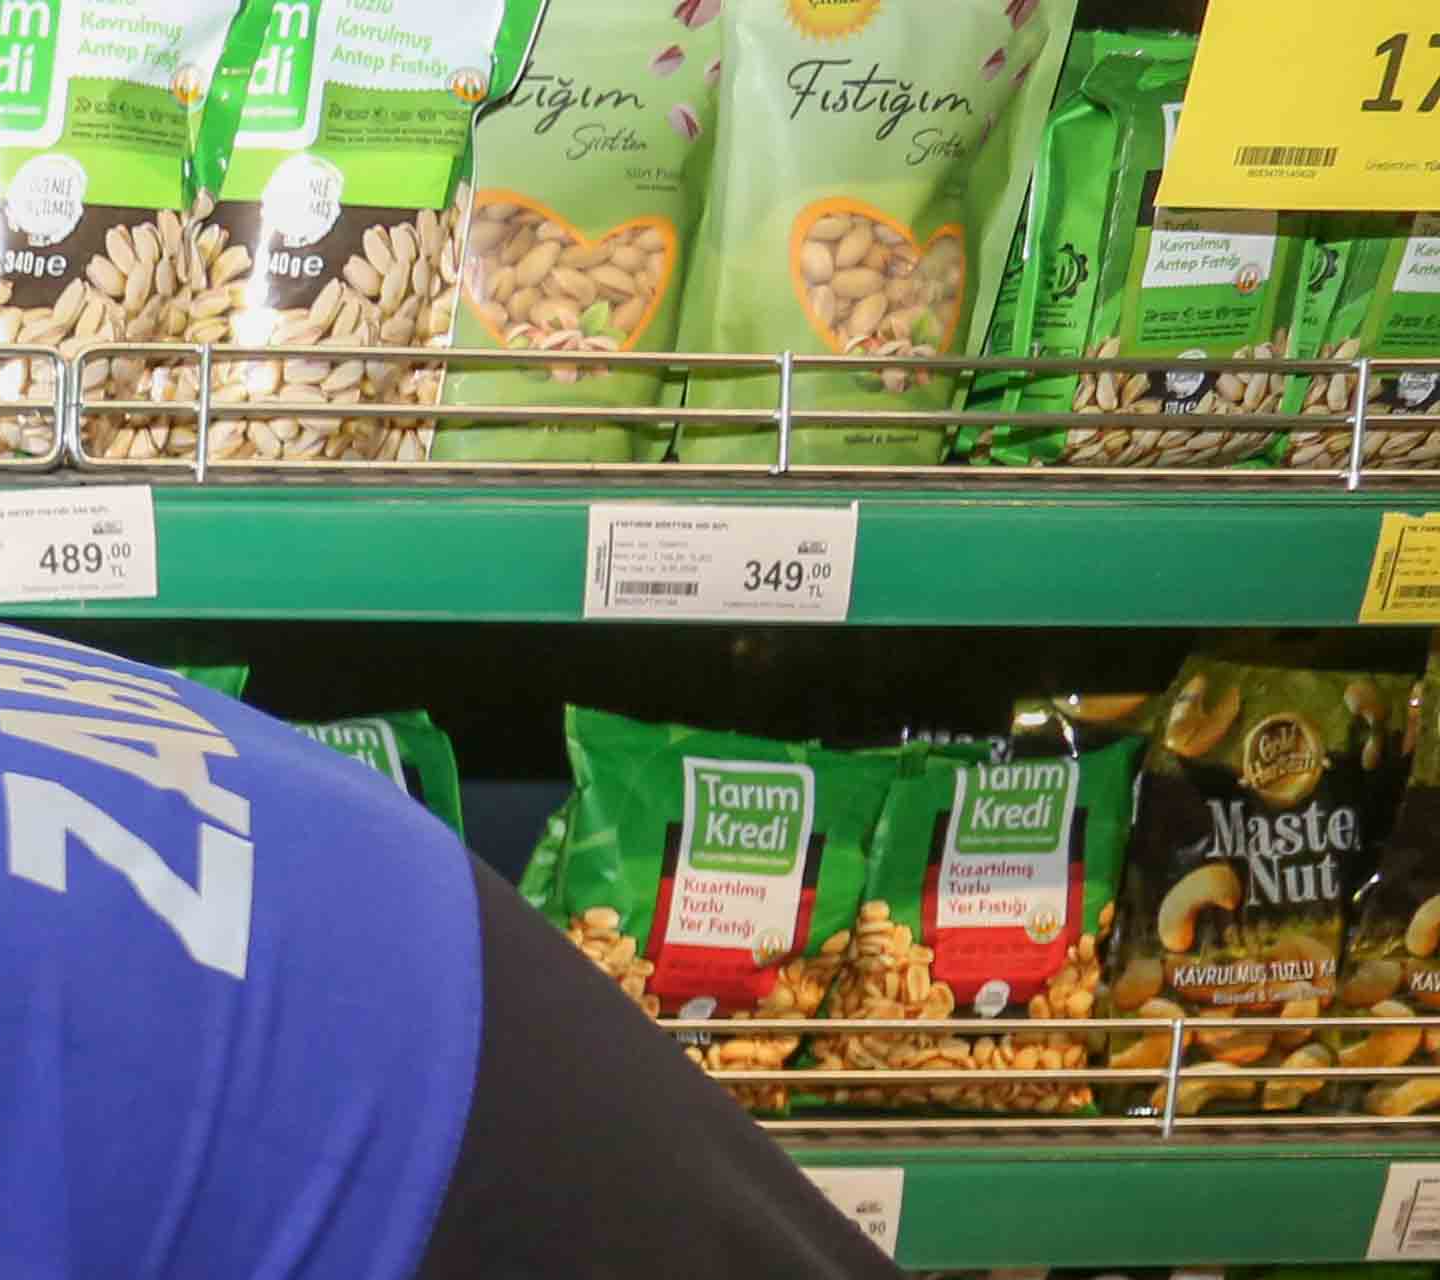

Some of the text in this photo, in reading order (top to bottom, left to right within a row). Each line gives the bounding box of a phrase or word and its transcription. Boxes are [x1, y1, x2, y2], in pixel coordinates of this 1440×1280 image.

[336, 15, 433, 49] Kavrulmuş
[330, 45, 385, 71] Antep
[786, 57, 973, 142] Fıstığım
[699, 774, 800, 813] Tarım
[971, 794, 1053, 830] Kredi
[705, 811, 789, 852] Kredi
[1205, 800, 1360, 859] Maste
[949, 861, 1035, 881] Kızartılmış
[1247, 853, 1342, 907] Nut
[682, 878, 768, 903] Kızartılmış
[948, 880, 992, 896] Tuzlu
[682, 895, 725, 914] Tuzlu
[948, 898, 1029, 915] Yer Fıstığı
[680, 915, 756, 939] Yer Fıstığı
[1271, 962, 1315, 981] TUZLU
